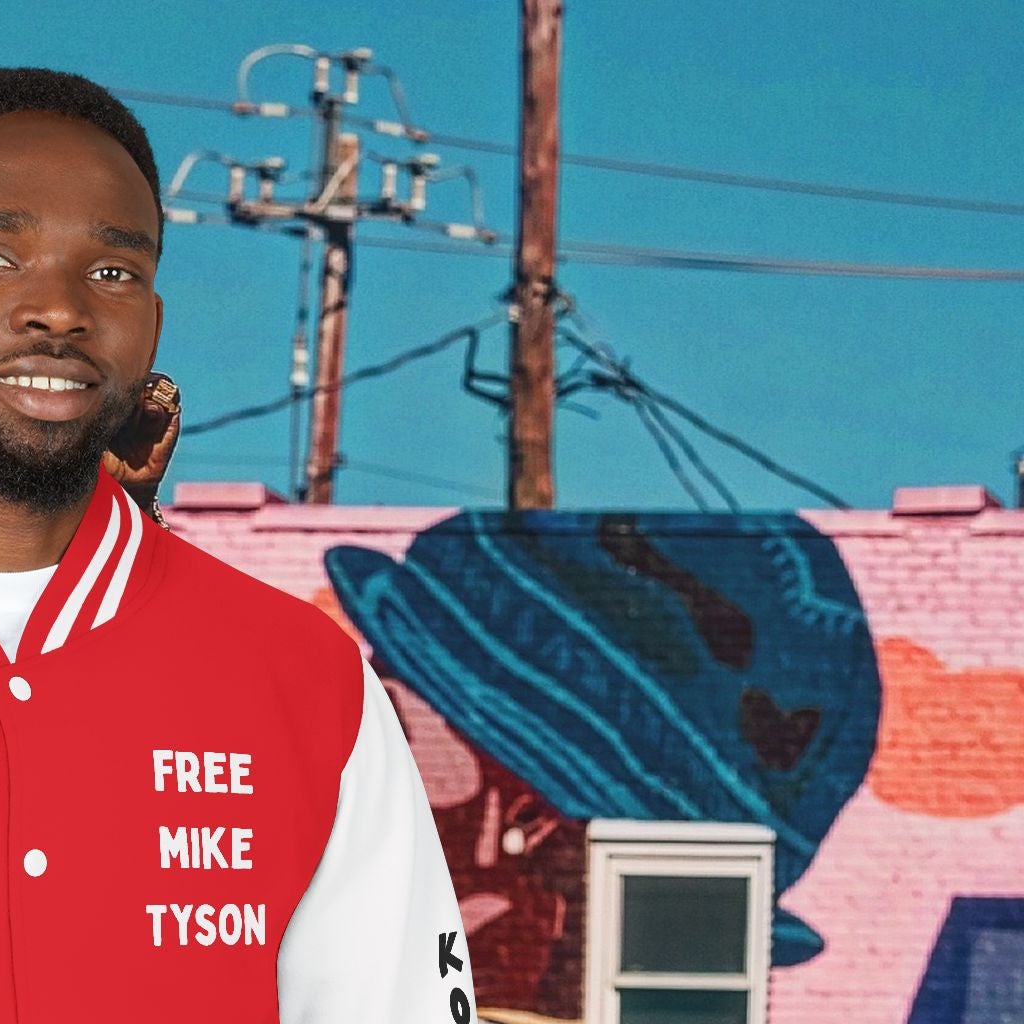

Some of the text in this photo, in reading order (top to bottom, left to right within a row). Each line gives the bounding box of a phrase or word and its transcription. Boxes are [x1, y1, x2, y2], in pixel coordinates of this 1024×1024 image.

[153, 749, 254, 795] FREE
[159, 825, 253, 869] MIKE
[145, 903, 266, 946] TYSON
